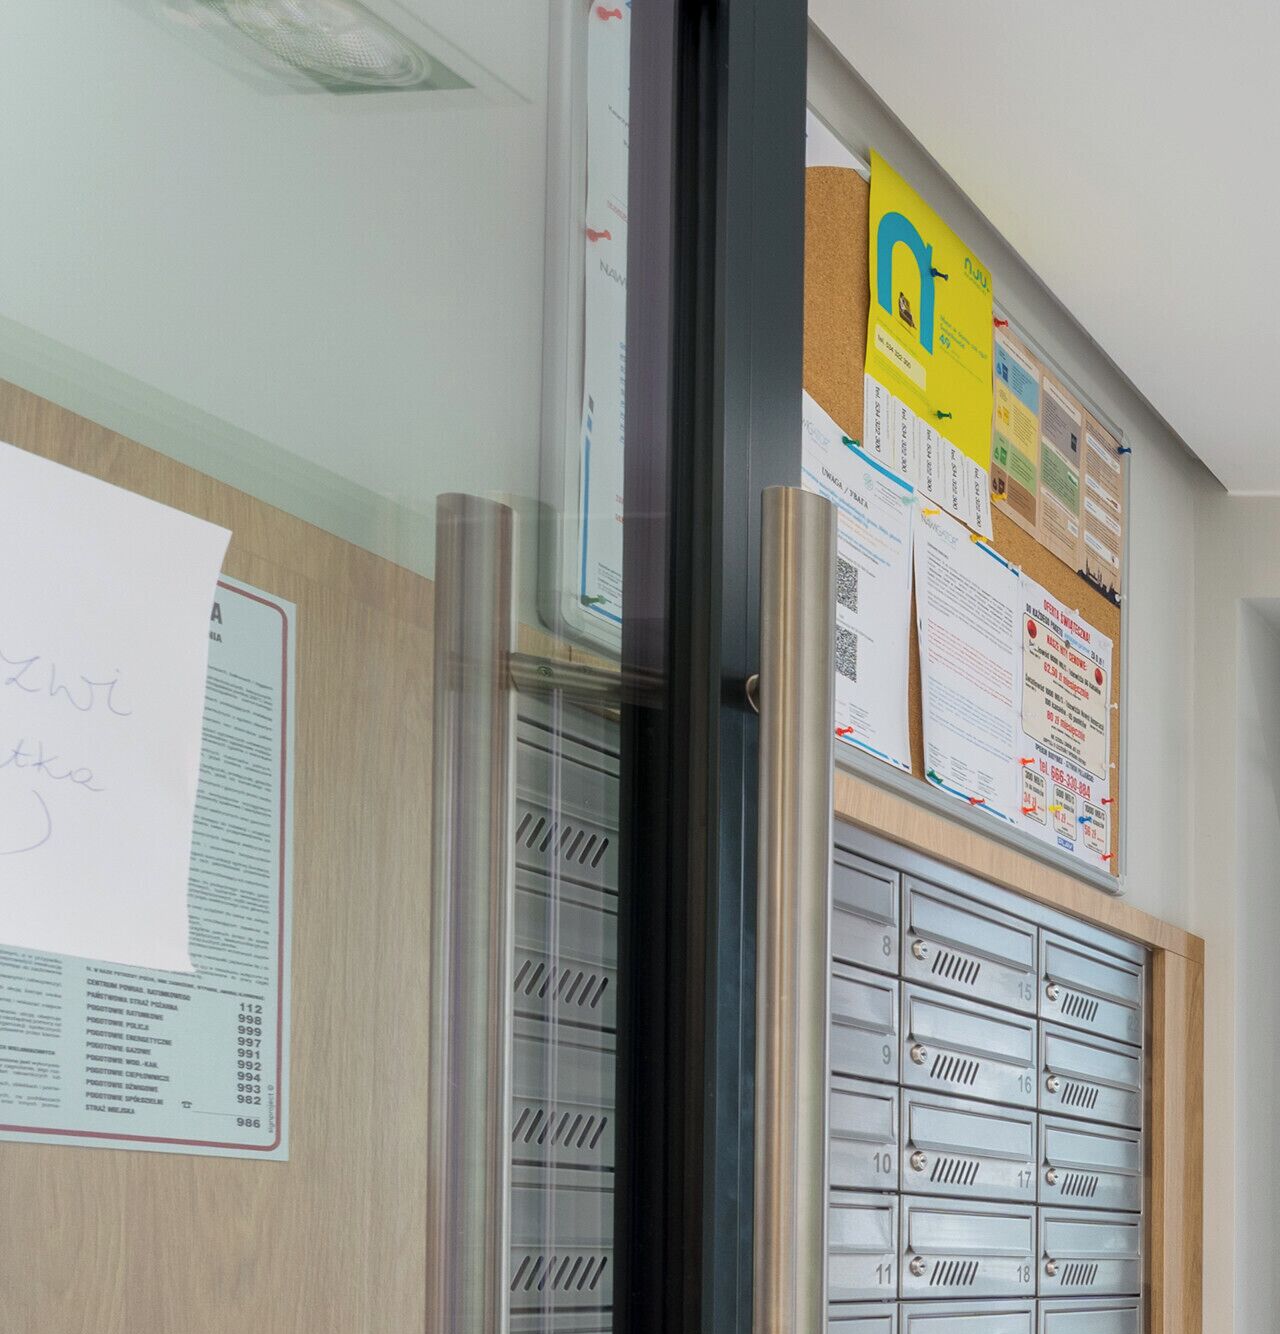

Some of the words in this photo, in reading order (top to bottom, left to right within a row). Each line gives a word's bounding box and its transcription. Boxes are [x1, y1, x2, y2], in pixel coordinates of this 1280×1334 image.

[821, 466, 843, 489] UWAGA
[1043, 600, 1060, 621] OFERTA
[1039, 757, 1049, 776] tel.
[882, 935, 891, 956] 8
[1018, 981, 1033, 1001] 15
[239, 1002, 263, 1015] 112
[238, 1014, 262, 1026] 998
[238, 1025, 262, 1037] 999
[237, 1036, 262, 1048] 997
[237, 1048, 261, 1060] 991
[882, 1044, 891, 1065] 9
[237, 1060, 262, 1071] 992
[236, 1071, 261, 1082] 994
[1018, 1074, 1032, 1095] 16
[236, 1082, 261, 1094] 993
[236, 1094, 261, 1105] 982
[236, 1117, 261, 1128] 986
[873, 1153, 891, 1174] 10
[1017, 1170, 1032, 1189] 17
[875, 1264, 892, 1285] 11
[1016, 1264, 1031, 1284] 18
